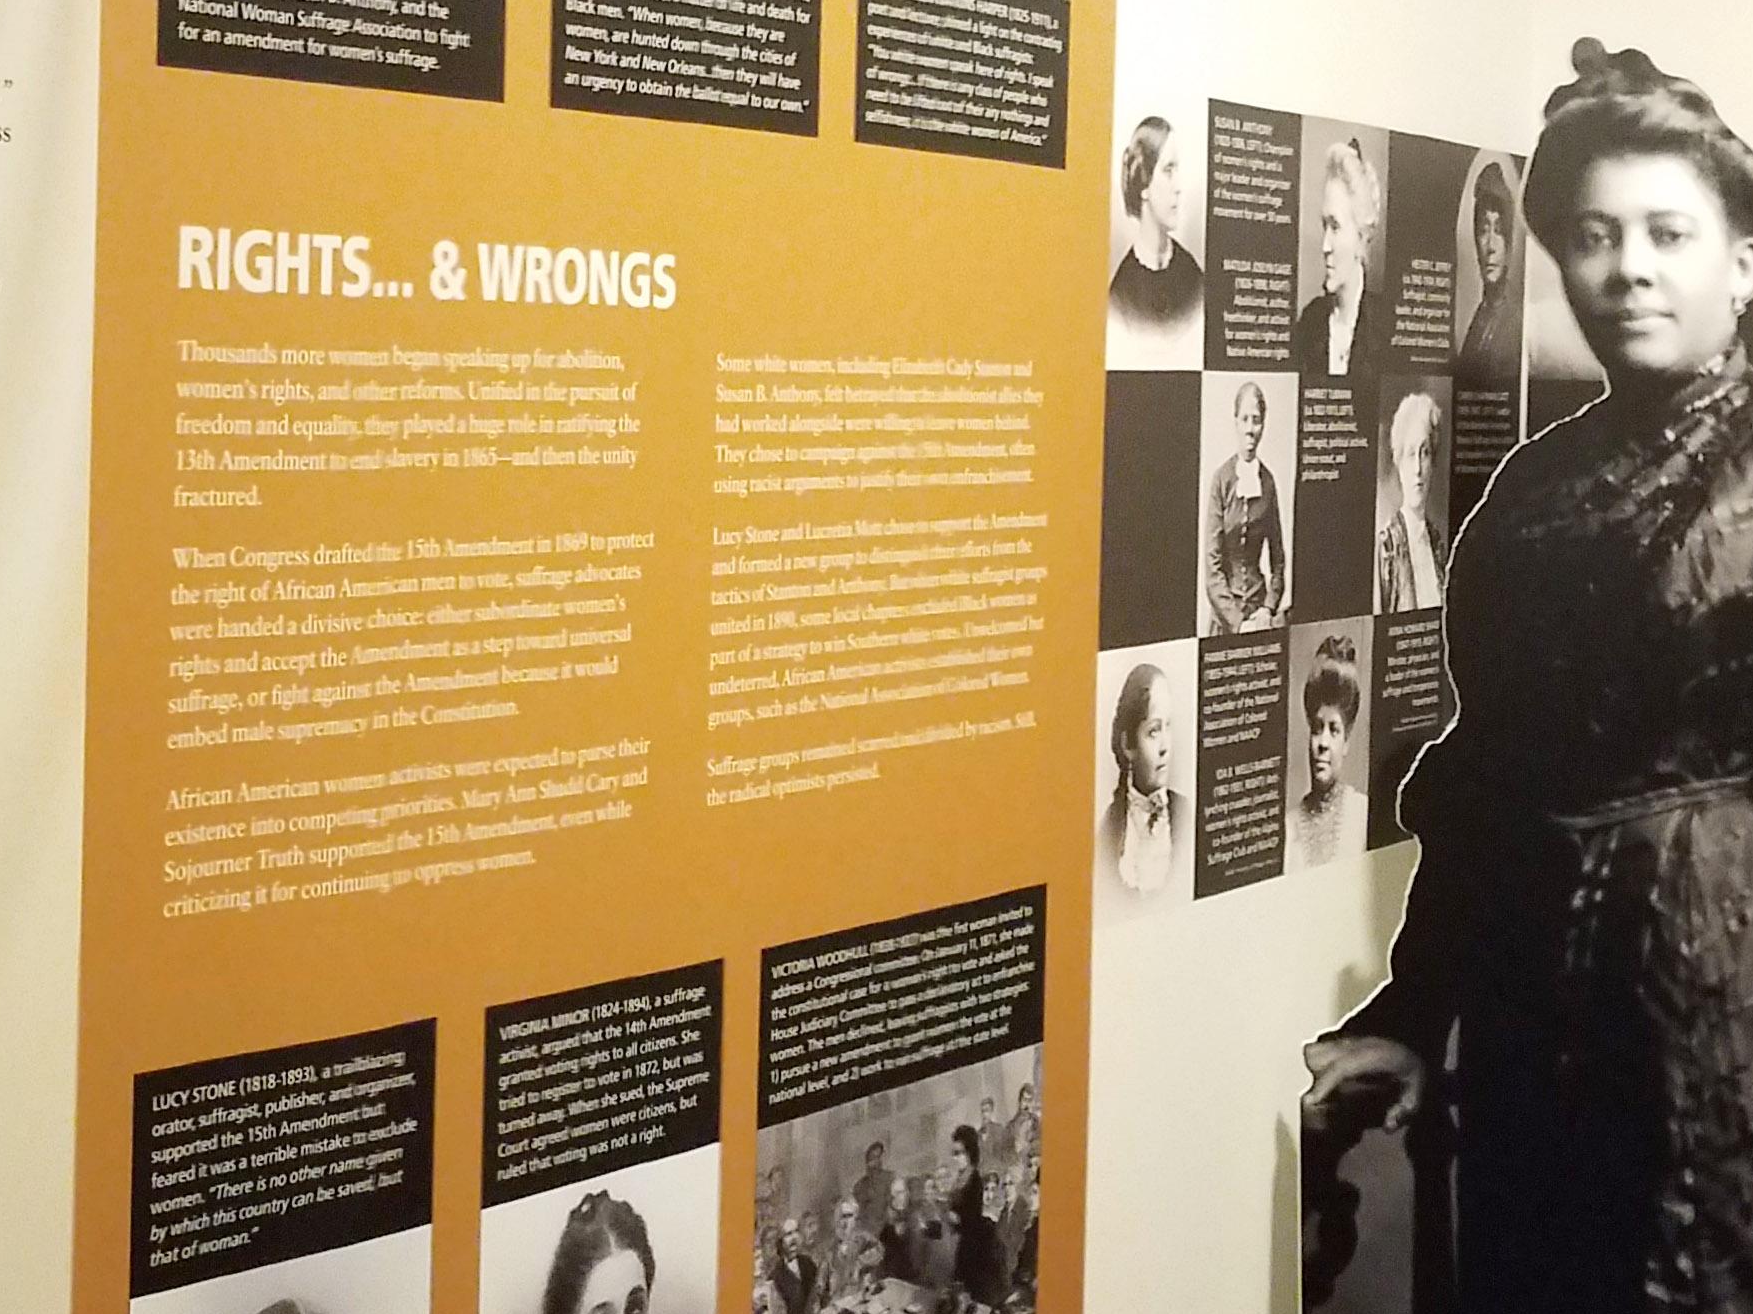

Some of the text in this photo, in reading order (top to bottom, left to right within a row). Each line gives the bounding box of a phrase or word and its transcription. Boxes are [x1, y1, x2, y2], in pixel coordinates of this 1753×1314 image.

[177, 224, 676, 310] RIGHTS... & WRONGS
[151, 1088, 191, 1112] LUCY
[191, 1078, 236, 1104] STONE
